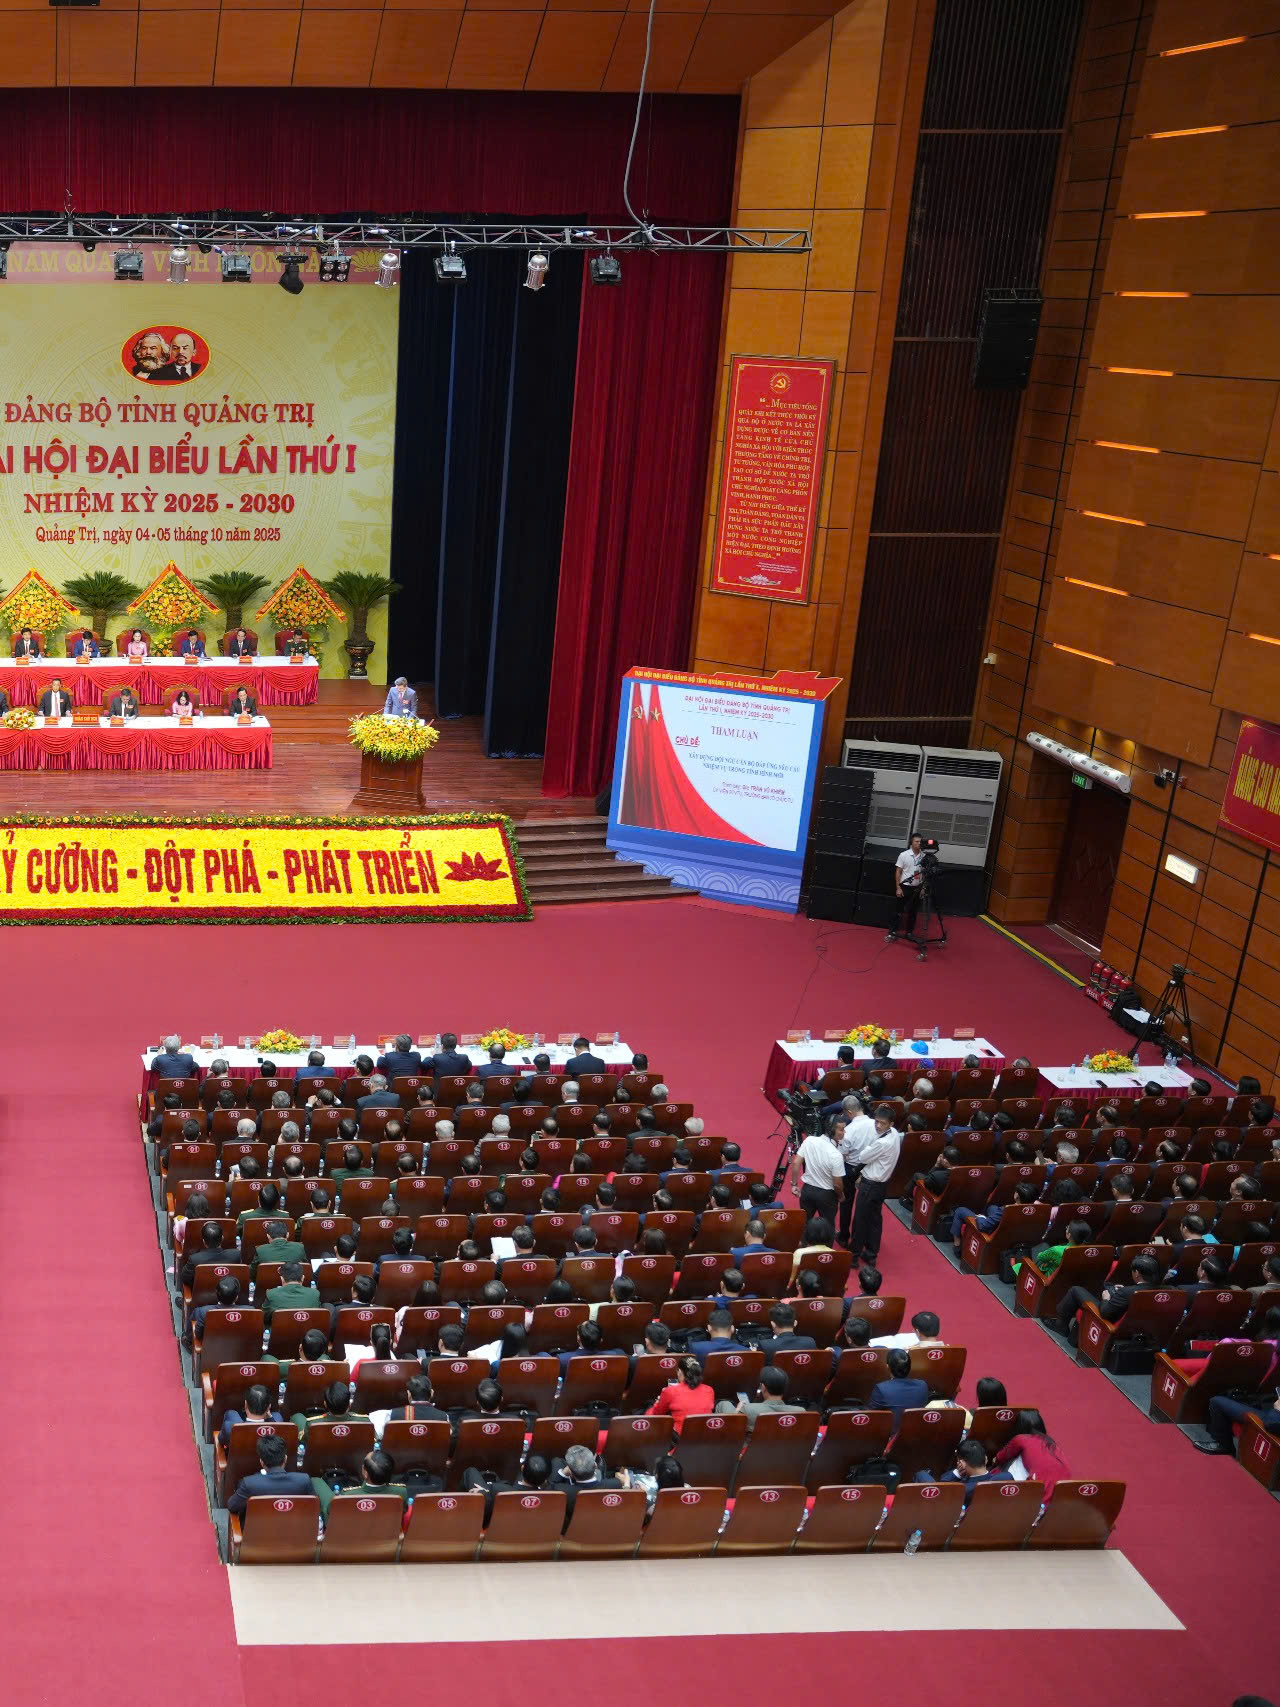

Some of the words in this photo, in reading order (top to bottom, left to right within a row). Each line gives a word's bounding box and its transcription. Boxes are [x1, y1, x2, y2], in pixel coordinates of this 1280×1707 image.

[8, 250, 59, 272] NAM
[5, 394, 73, 424] ĐẢNG
[78, 395, 112, 428] BỘ
[117, 394, 176, 424] TỈNH
[184, 394, 268, 427] QUẢNG
[274, 402, 315, 428] TRỊ
[23, 437, 78, 480] HỘI
[86, 444, 139, 479] ĐẠI
[149, 432, 208, 475] BIỂU
[218, 434, 278, 475] LẦN
[285, 433, 340, 474] THỨ
[345, 443, 357, 474] I
[24, 486, 114, 518] NHIỆM
[121, 486, 158, 513] KỲ
[163, 493, 219, 513] 2025
[240, 493, 295, 513] 2030
[35, 523, 75, 545] Quảng
[79, 527, 100, 544] Trị,
[103, 526, 133, 545] ngày
[174, 525, 209, 545] tháng
[211, 528, 223, 542] 10
[226, 526, 251, 542] năm
[253, 528, 282, 542] 2025
[711, 726, 734, 737] THAM
[737, 729, 759, 741] LUẬN
[675, 736, 688, 744] CHỦ
[144, 840, 195, 902] ĐỘT
[204, 840, 261, 893] PHÁ
[284, 839, 352, 893] PHÁT
[358, 832, 440, 894] TRIỂN
[921, 1202, 927, 1213] D
[970, 1242, 978, 1254] E
[1026, 1277, 1034, 1289] F
[1089, 1327, 1099, 1340] G
[1164, 1378, 1176, 1393] H
[278, 1501, 289, 1509] 01
[360, 1501, 372, 1509] 03
[441, 1500, 453, 1508] 05
[524, 1498, 536, 1506] 07
[606, 1496, 618, 1504] 09
